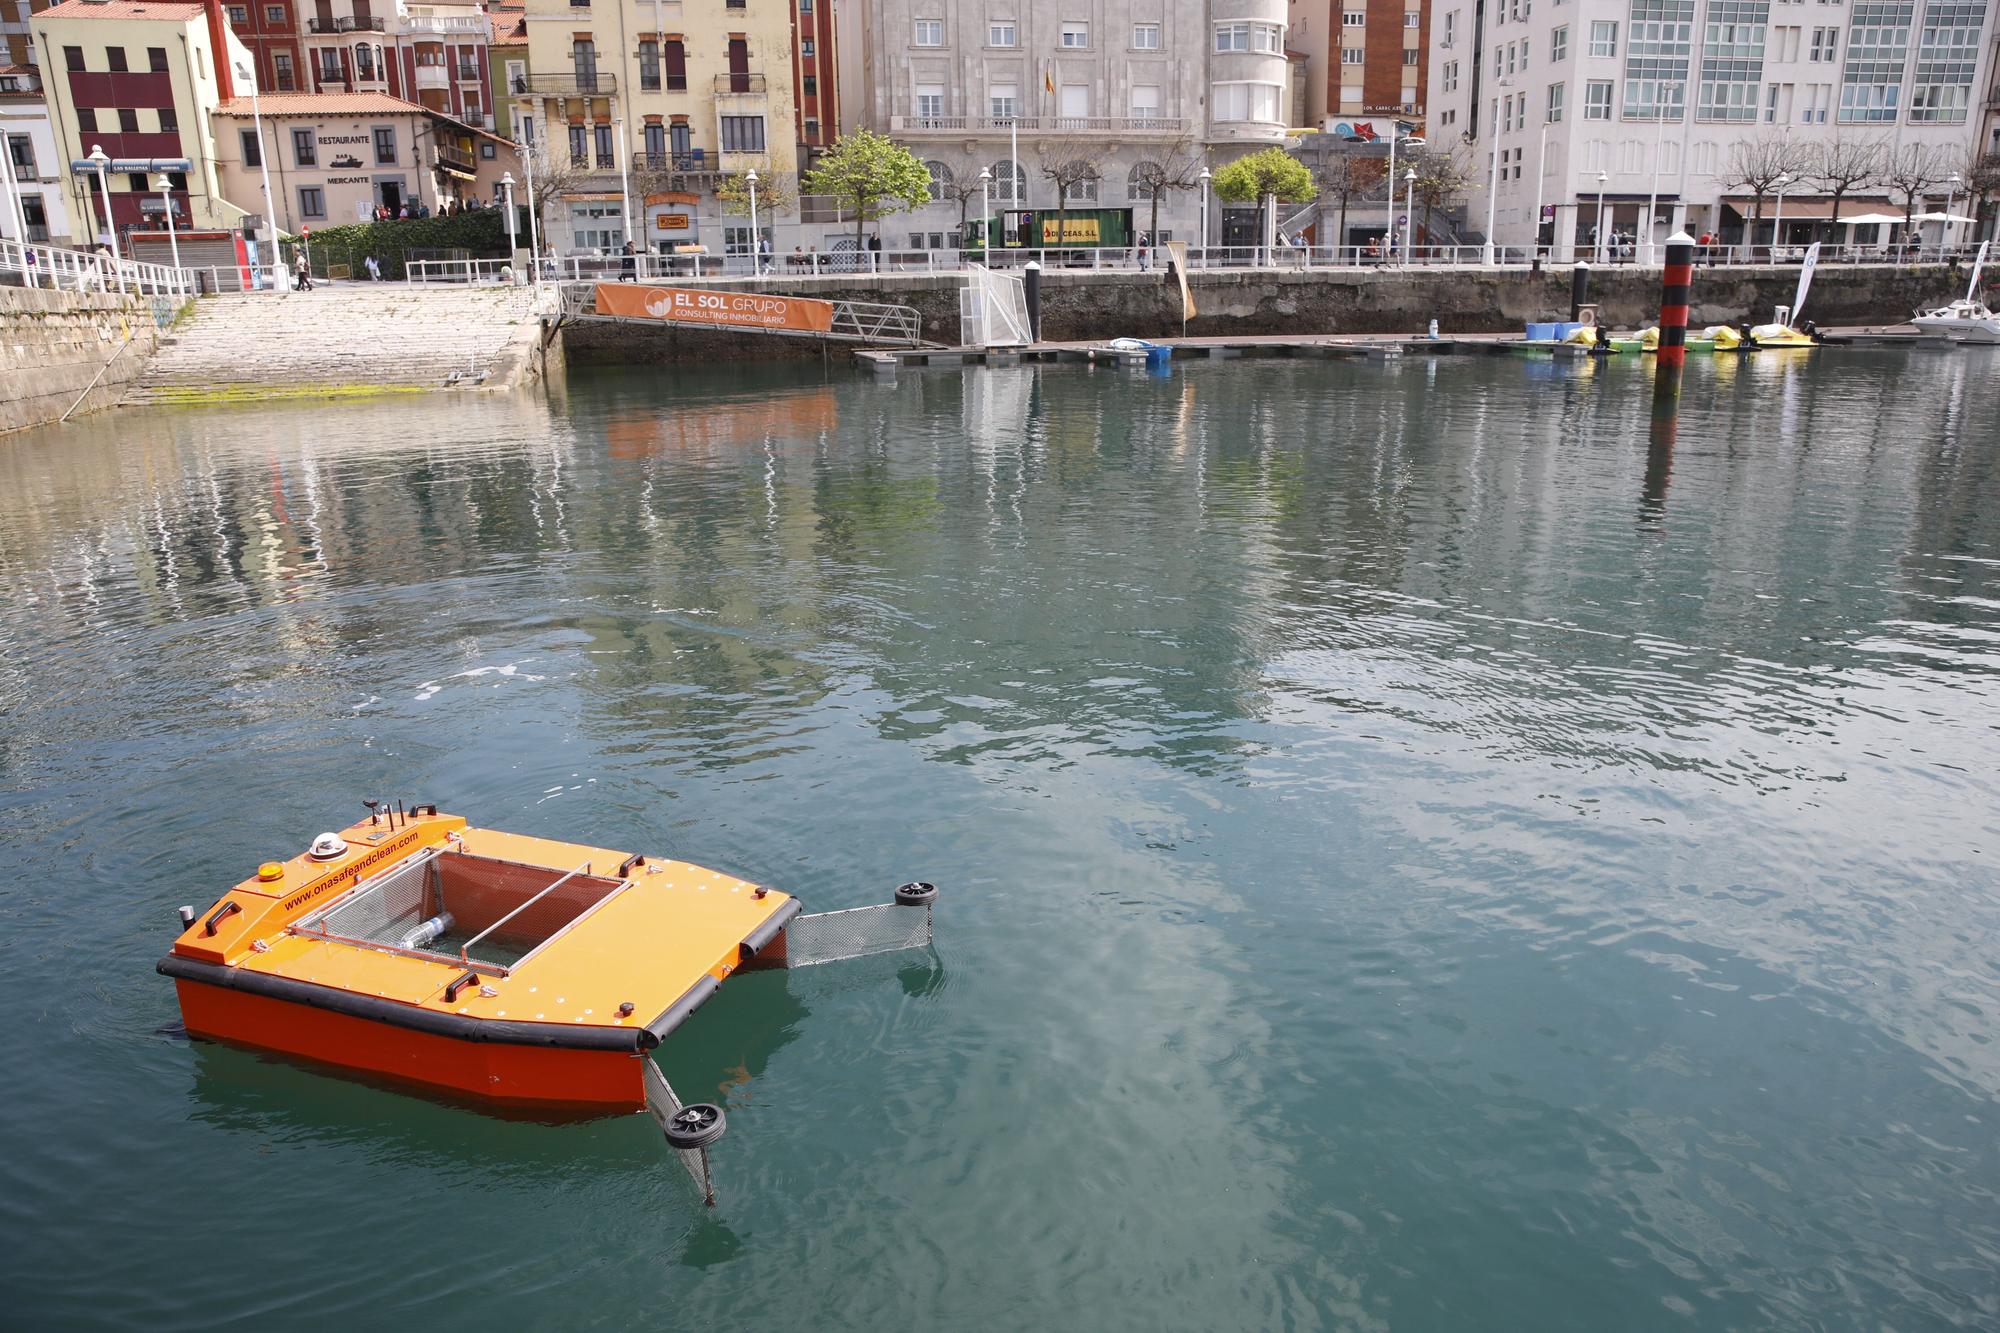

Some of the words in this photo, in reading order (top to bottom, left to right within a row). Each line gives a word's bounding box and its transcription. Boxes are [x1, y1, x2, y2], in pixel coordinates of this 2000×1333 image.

[318, 136, 370, 144] RESTAURANTE
[675, 293, 694, 307] EL
[698, 295, 729, 310] SOL
[732, 298, 786, 314] GRUPO
[675, 308, 728, 320] CONSULTING
[729, 313, 786, 325] INMOBILIARIO
[284, 831, 418, 911] www.onasafeandclean.com
